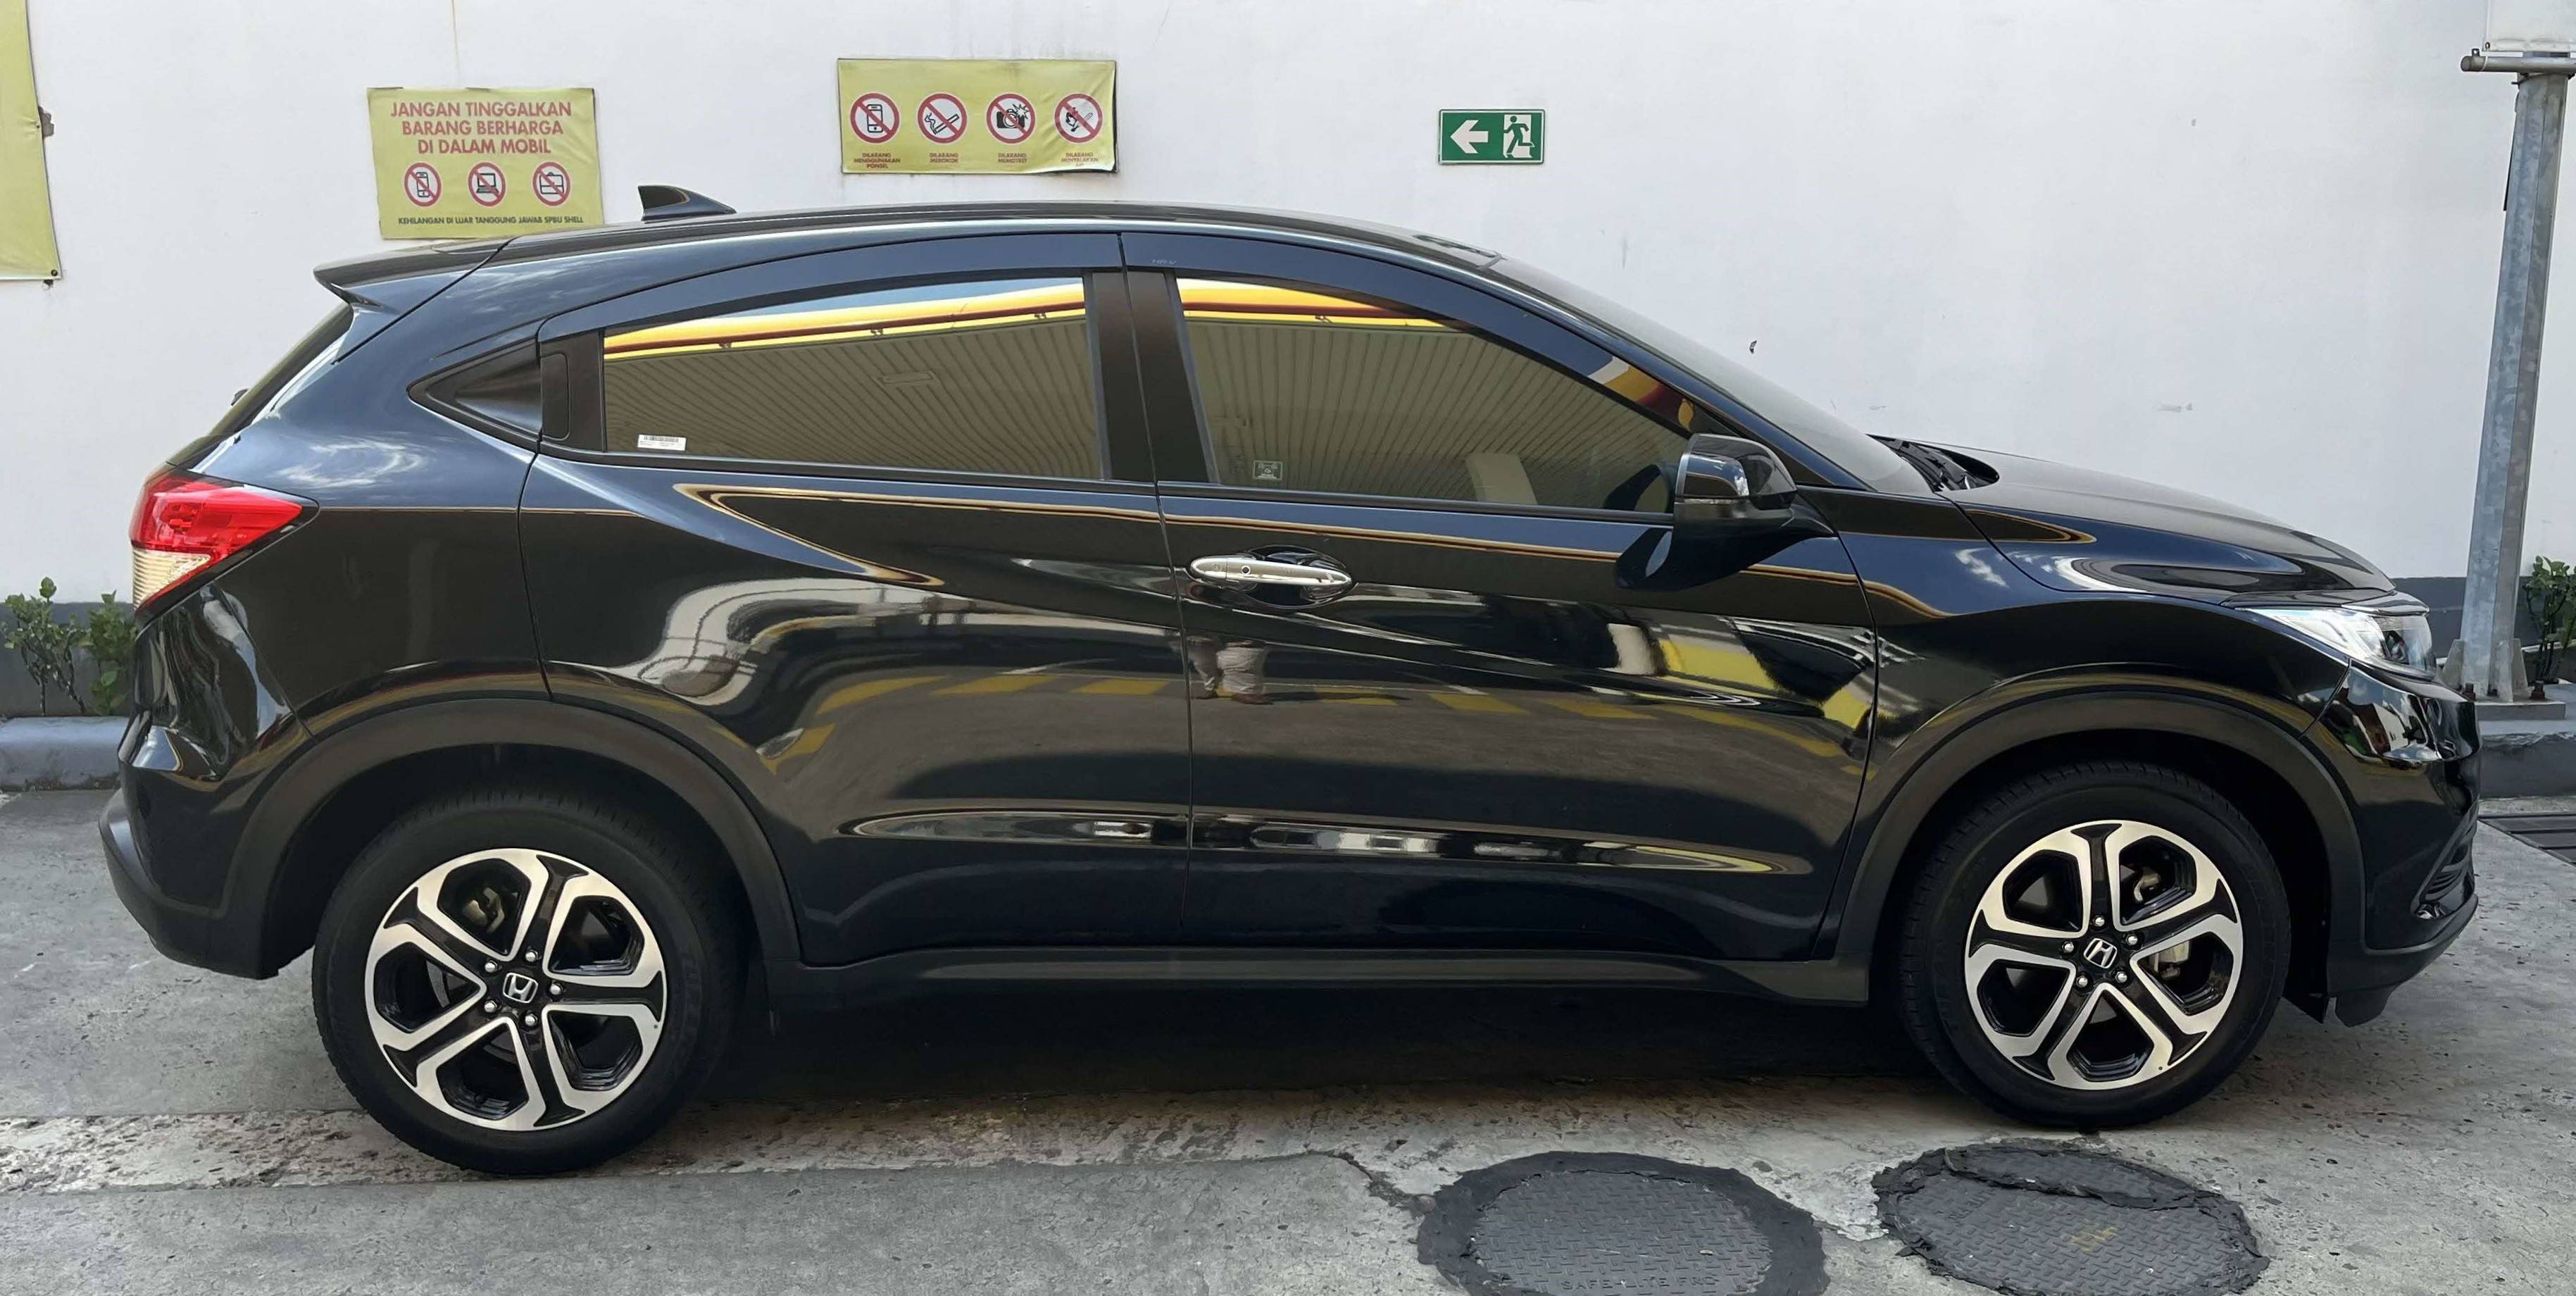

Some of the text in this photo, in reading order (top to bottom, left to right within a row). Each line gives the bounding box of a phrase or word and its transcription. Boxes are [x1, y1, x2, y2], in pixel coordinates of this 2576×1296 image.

[390, 101, 572, 117] JANGAN TINGGALKAN
[402, 120, 563, 135] BARANG BERHARGA
[418, 139, 551, 154] DI DALAM MOBIL
[475, 216, 517, 224] TANGGUNG
[518, 216, 543, 224] JAWAB
